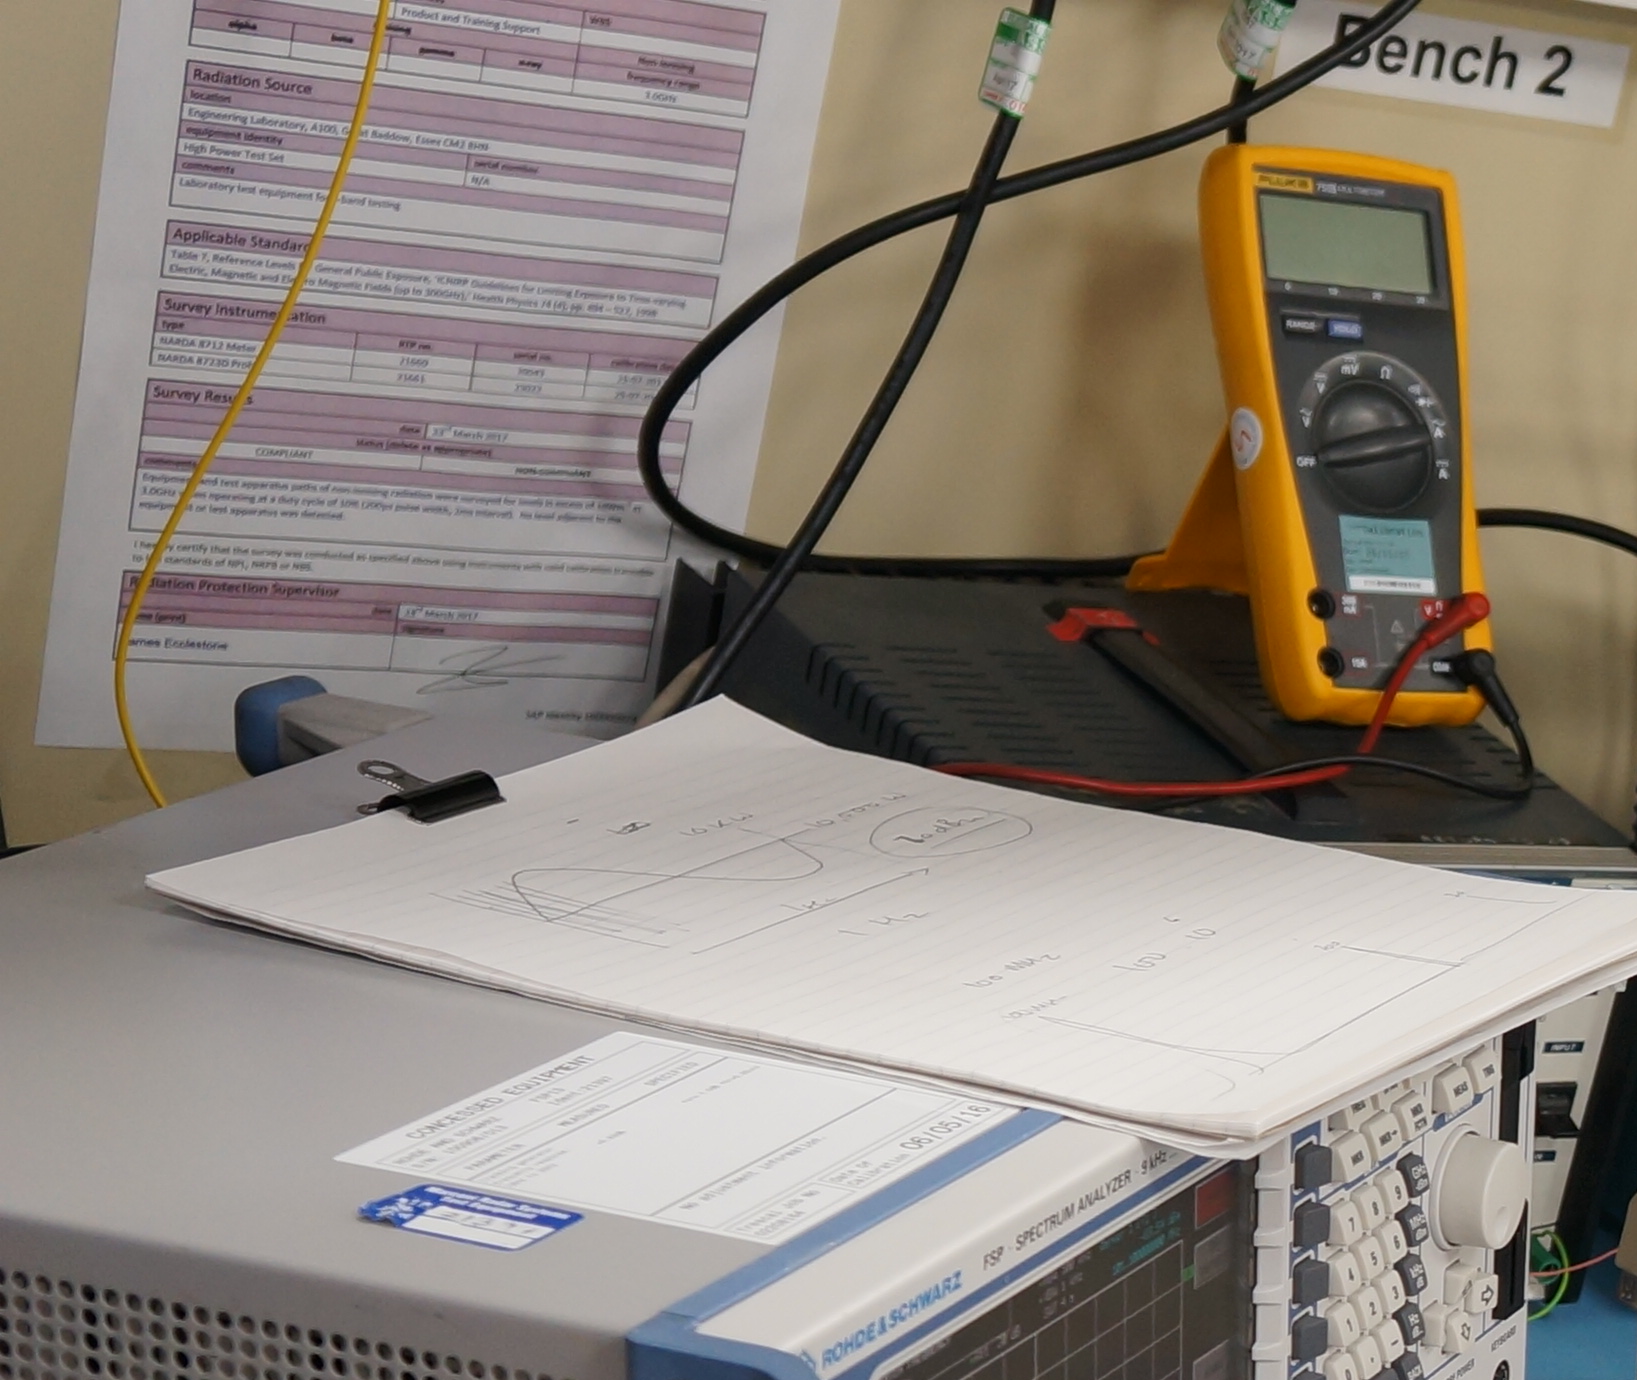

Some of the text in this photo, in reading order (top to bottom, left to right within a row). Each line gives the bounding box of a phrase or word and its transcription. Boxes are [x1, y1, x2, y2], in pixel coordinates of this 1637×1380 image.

[1334, 13, 1519, 90] Bench
[1536, 45, 1574, 97] 2
[193, 68, 313, 95] Radiation Source
[184, 142, 207, 156] High
[210, 145, 241, 158] Power
[172, 228, 247, 248] Applicable
[163, 299, 212, 317] Survey
[154, 386, 200, 404] Survey
[198, 579, 268, 596] Protection
[406, 1054, 596, 1140] CONCESSED EQUIPMENT
[899, 1102, 992, 1153] 06/05/16
[1395, 1185, 1401, 1200] 9
[1371, 1201, 1379, 1216] 8
[982, 1245, 1005, 1271] FSP
[1015, 1202, 1076, 1252] SPECTRUM
[1076, 1169, 1132, 1214] ANALYZER
[1348, 1217, 1356, 1232] 7
[1392, 1235, 1400, 1249] 6
[1370, 1251, 1377, 1266] 5
[1348, 1267, 1355, 1282] 4
[1392, 1286, 1399, 1301] 3
[1369, 1301, 1377, 1317] 2
[1346, 1319, 1353, 1333] 1
